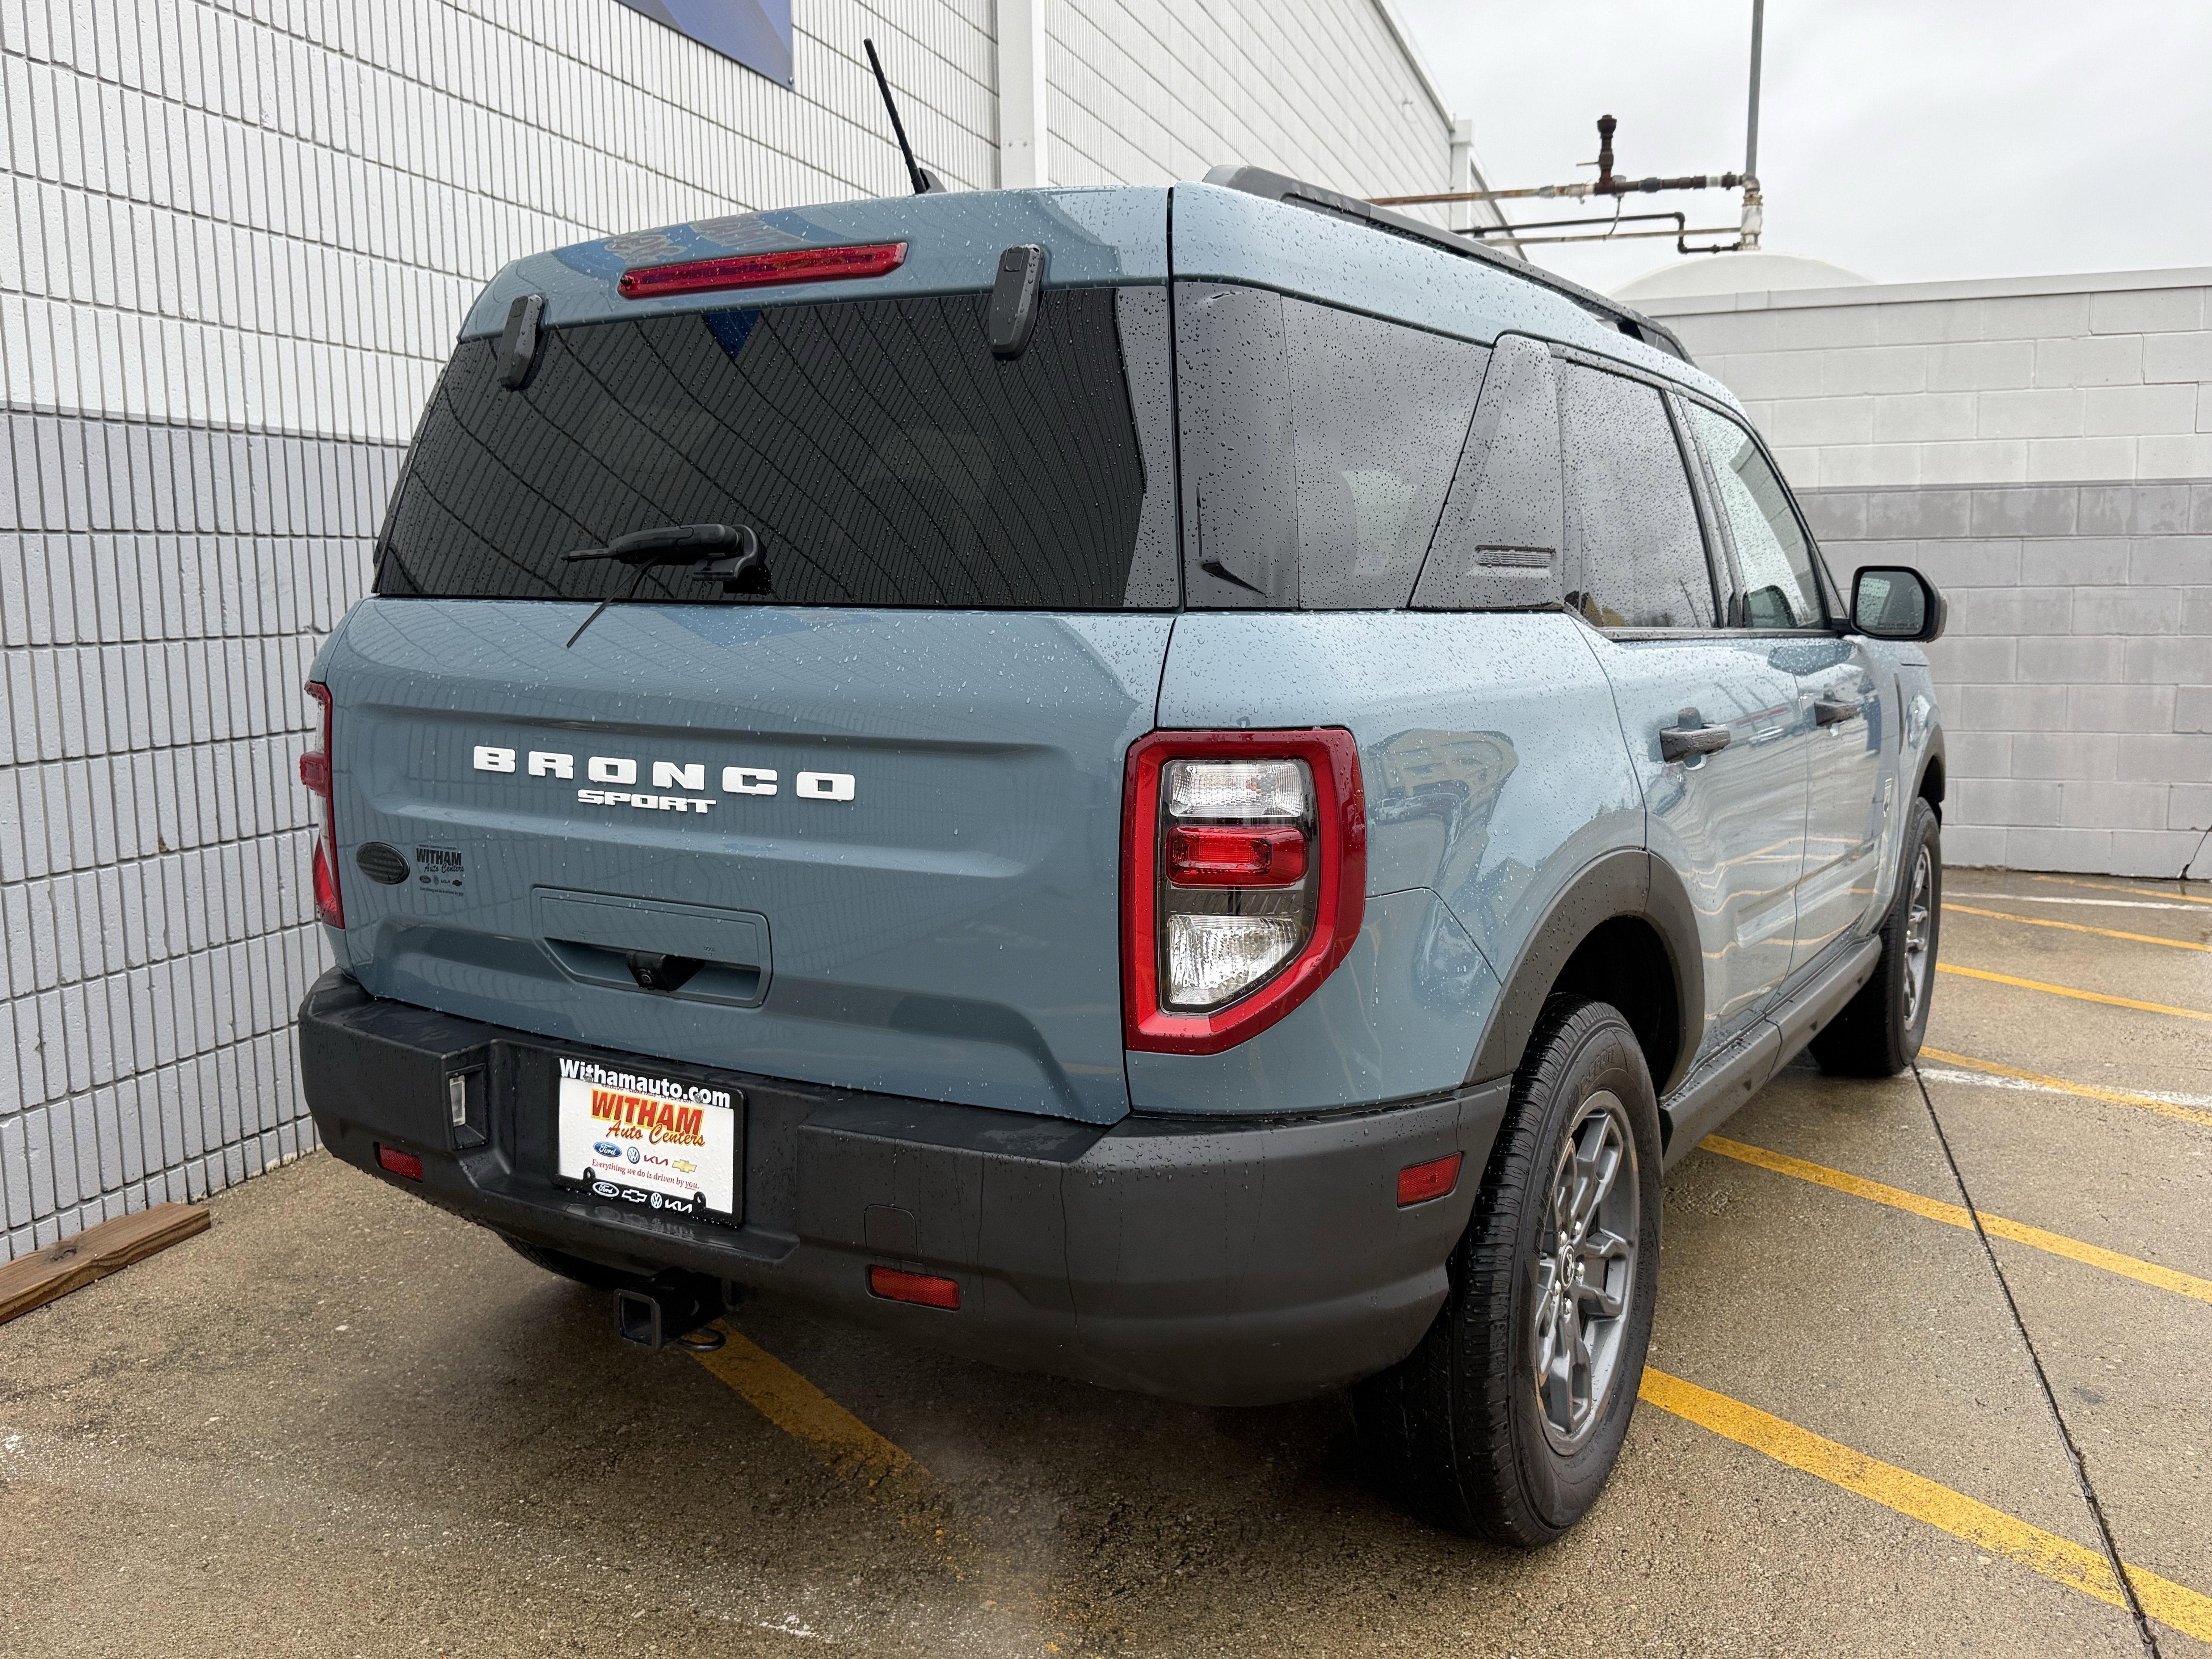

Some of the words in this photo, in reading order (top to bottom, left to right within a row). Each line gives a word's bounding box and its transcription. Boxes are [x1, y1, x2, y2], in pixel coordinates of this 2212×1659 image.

[473, 745, 855, 801] BRONCO
[577, 788, 716, 813] SPORT
[416, 848, 462, 866] WITHAM
[424, 863, 439, 873] Auto
[441, 862, 464, 873] Centers
[559, 1058, 731, 1108] Withamauto.com
[591, 1089, 705, 1135] WITHAM
[606, 1120, 644, 1139] Auto
[648, 1123, 706, 1147] Centers
[598, 1142, 617, 1156] Ford
[592, 1159, 626, 1175] Everything
[637, 1169, 646, 1177] do
[647, 1170, 653, 1178] is
[653, 1172, 675, 1184] driven
[676, 1177, 685, 1187] by
